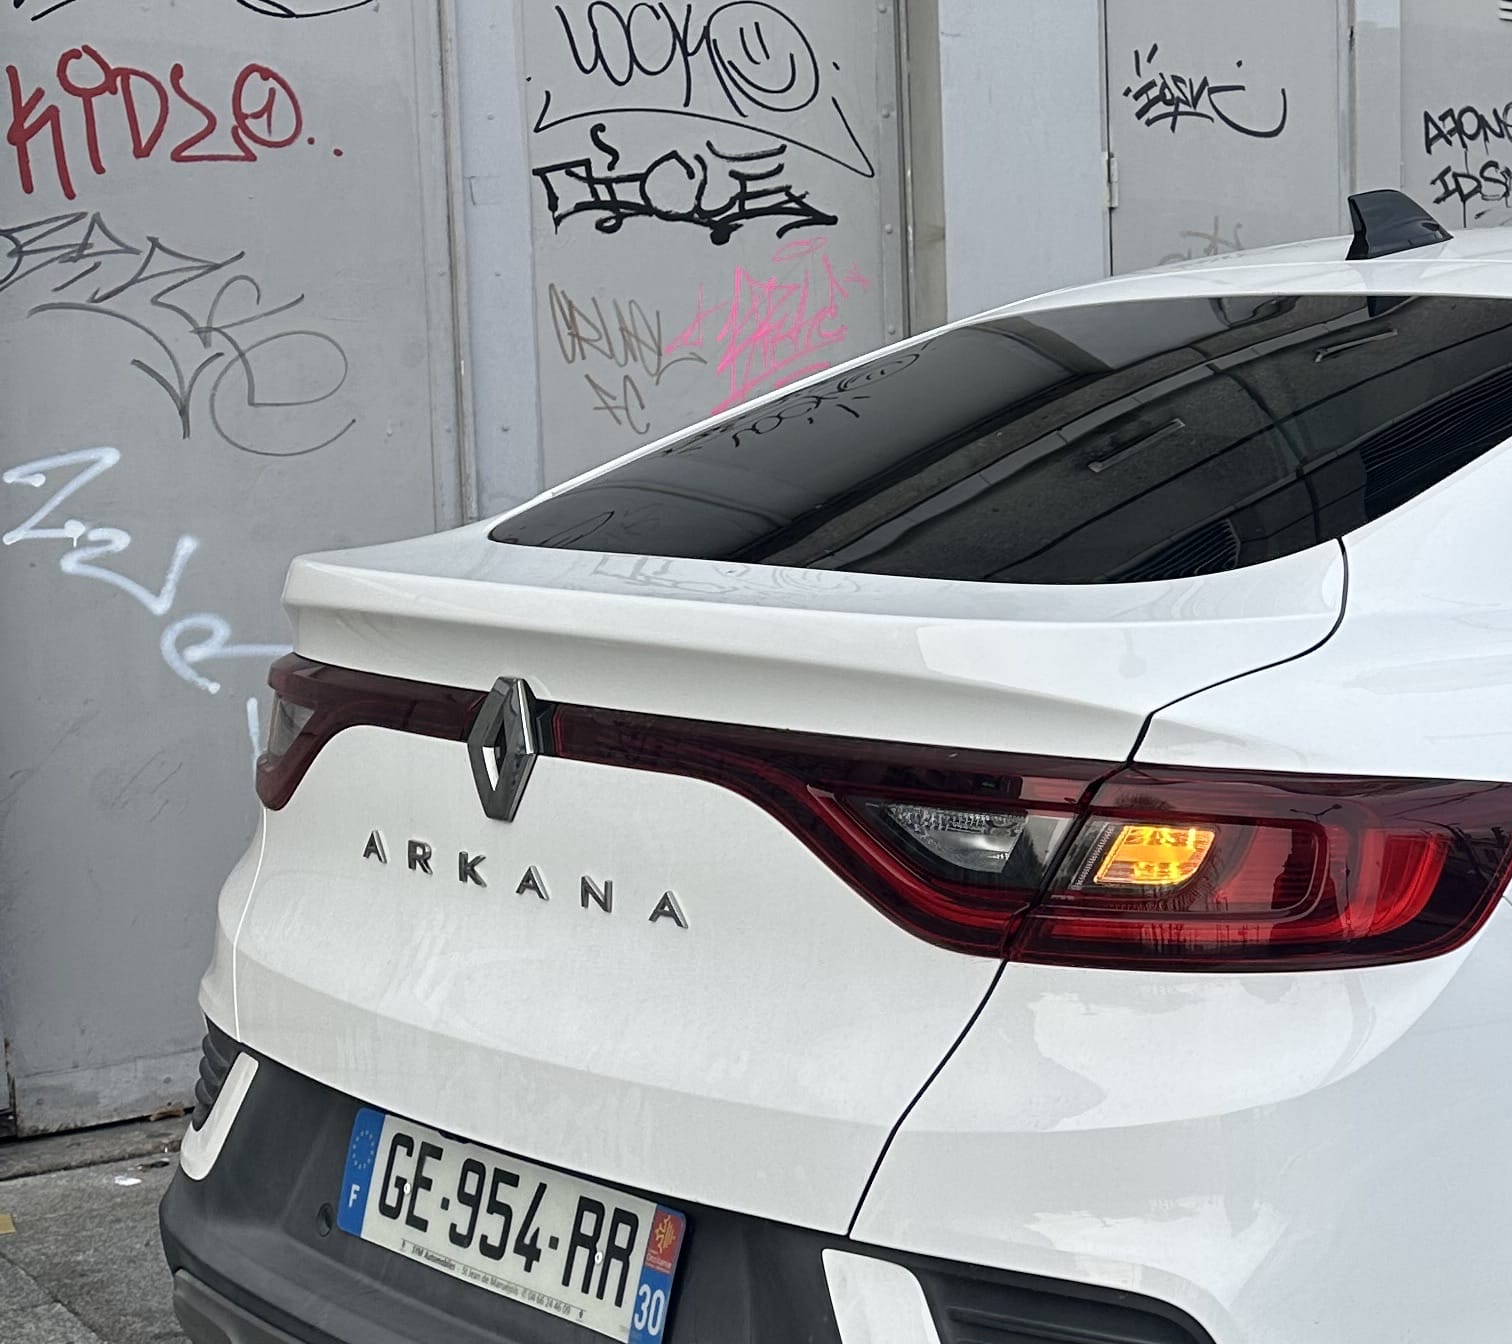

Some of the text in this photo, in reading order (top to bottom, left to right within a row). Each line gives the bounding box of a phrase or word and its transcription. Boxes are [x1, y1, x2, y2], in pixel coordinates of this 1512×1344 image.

[362, 829, 689, 929] ARKANA
[348, 1183, 361, 1208] F
[634, 1283, 665, 1337] 30
